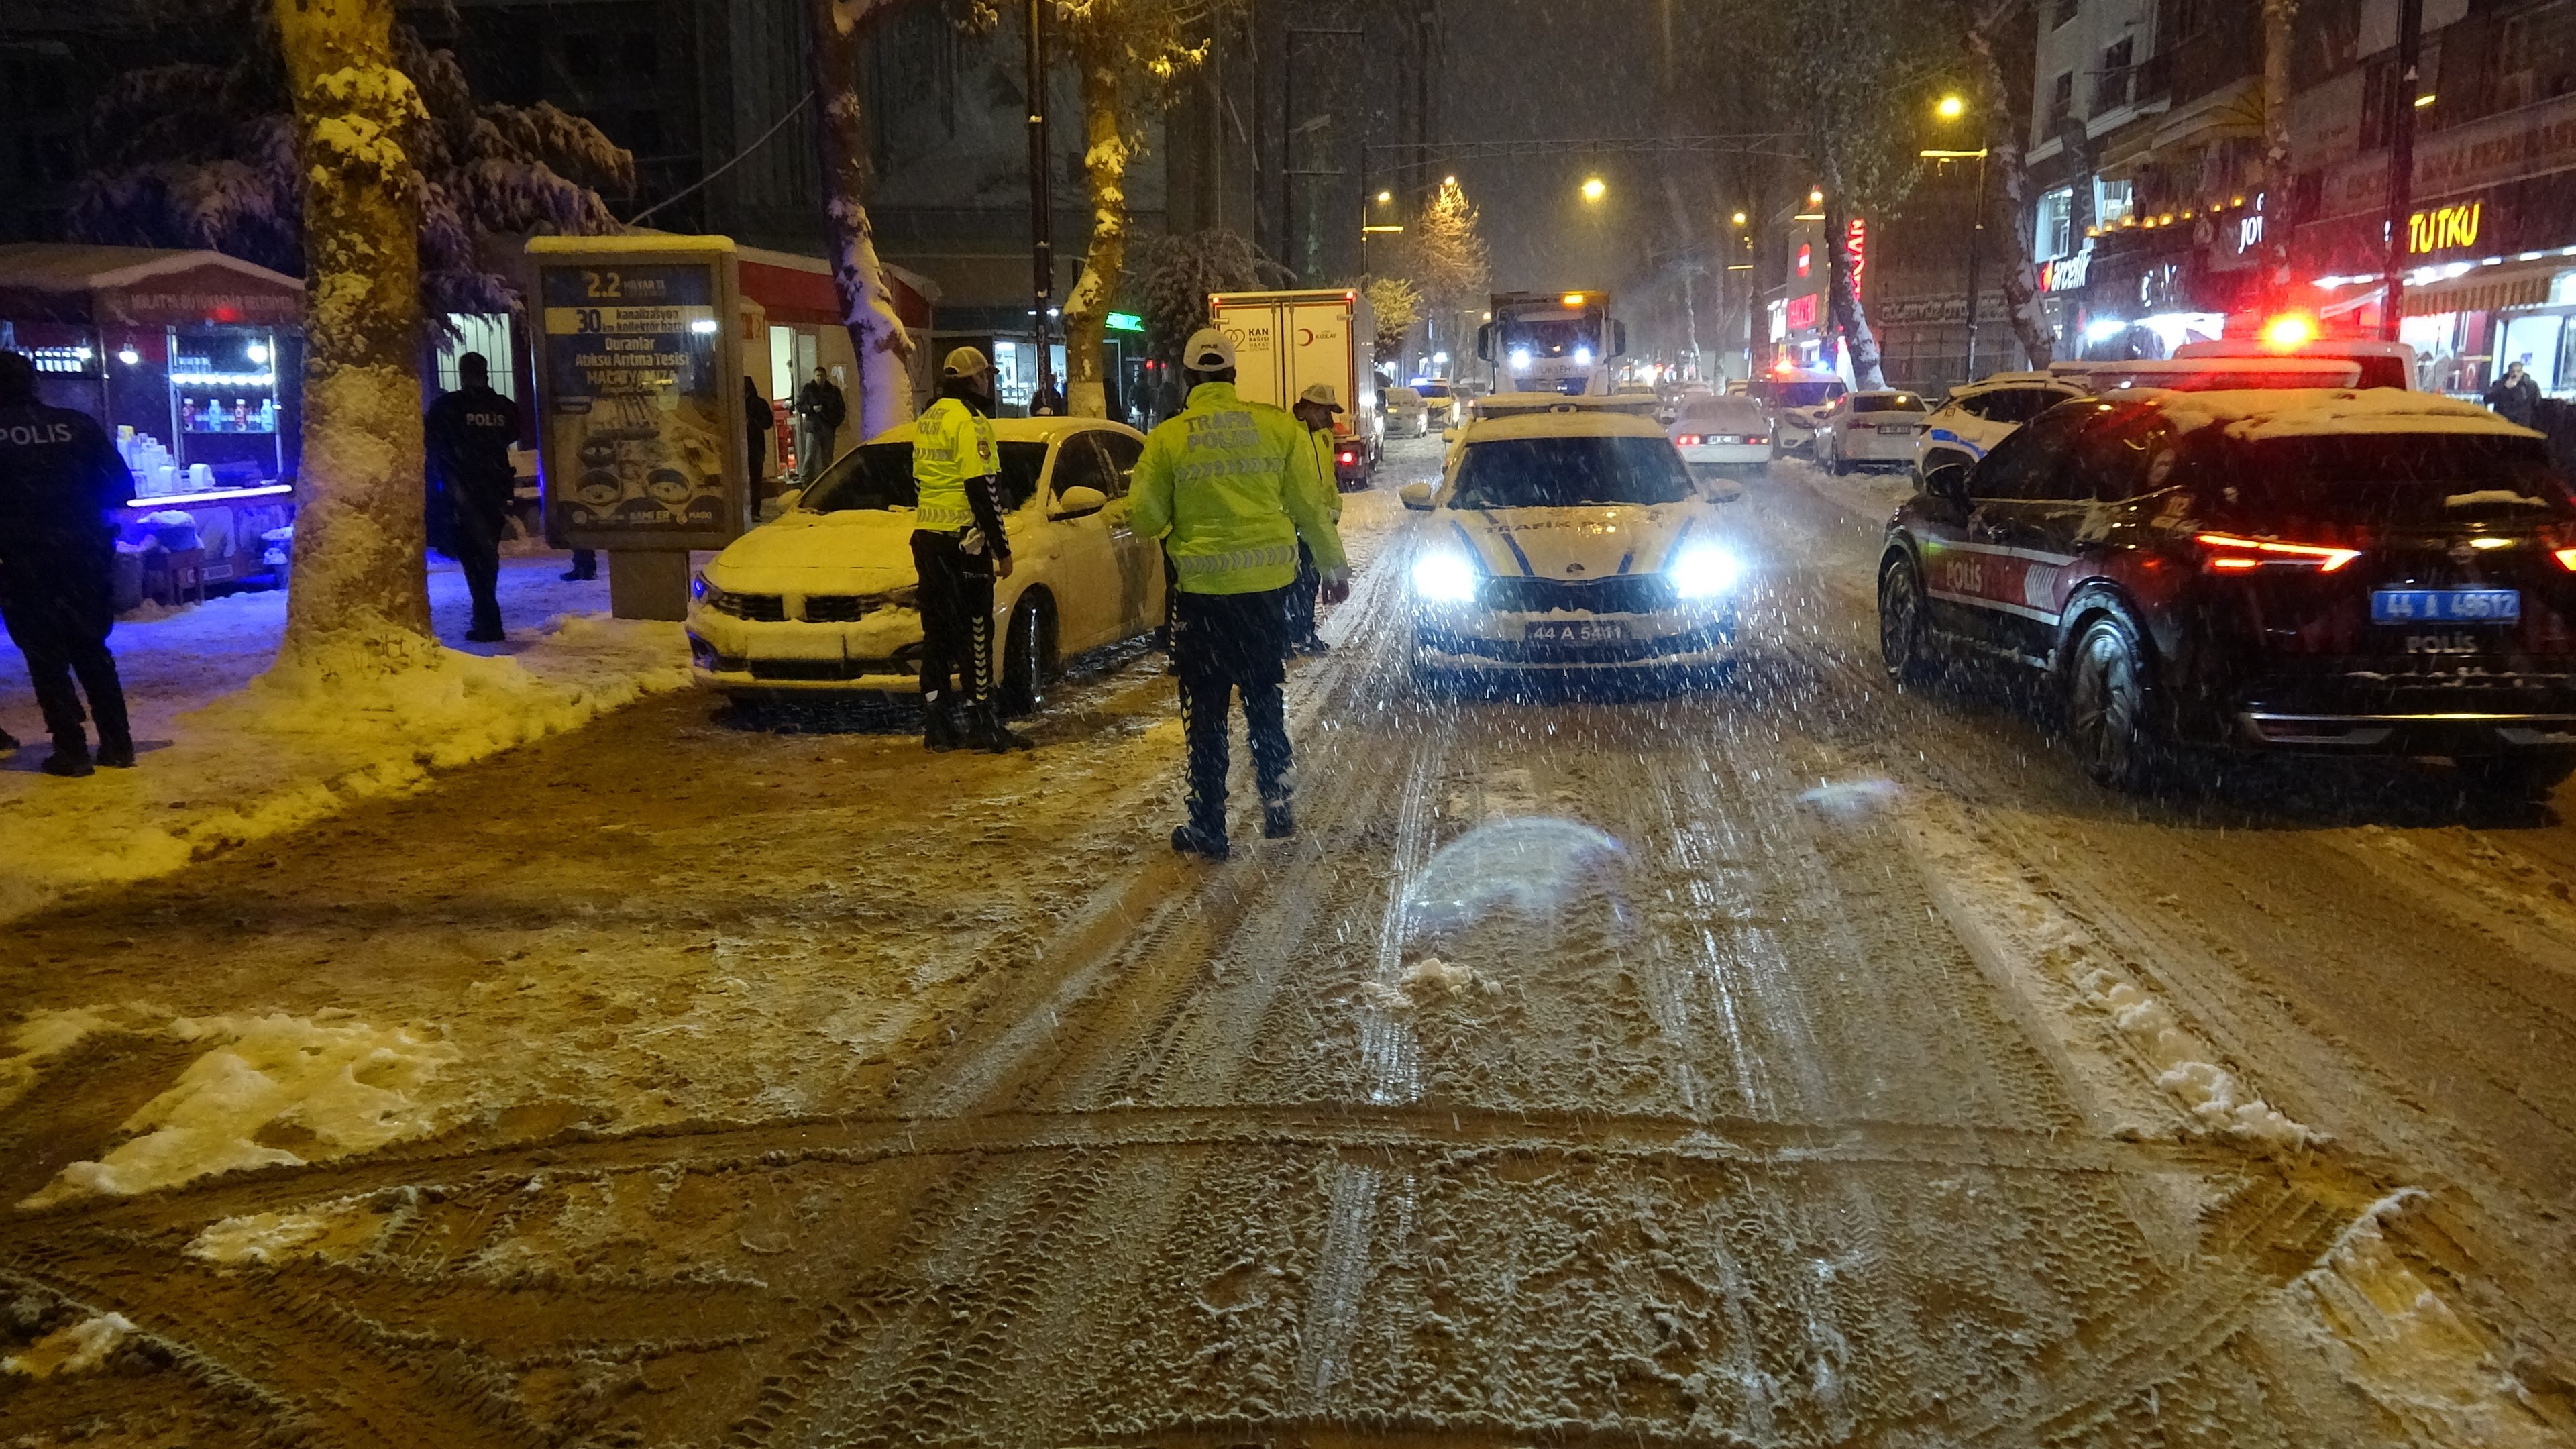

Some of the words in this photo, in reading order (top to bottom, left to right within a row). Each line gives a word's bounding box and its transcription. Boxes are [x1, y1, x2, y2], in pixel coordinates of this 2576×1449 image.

[2409, 203, 2480, 253] TUTKU
[587, 272, 622, 297] 2.2
[576, 309, 602, 333] 30
[1248, 328, 1269, 336] KAN
[1183, 411, 1257, 433] TRAFİK
[2387, 594, 2414, 616] 44
[1533, 626, 1556, 640] 44
[1560, 625, 1575, 640] A
